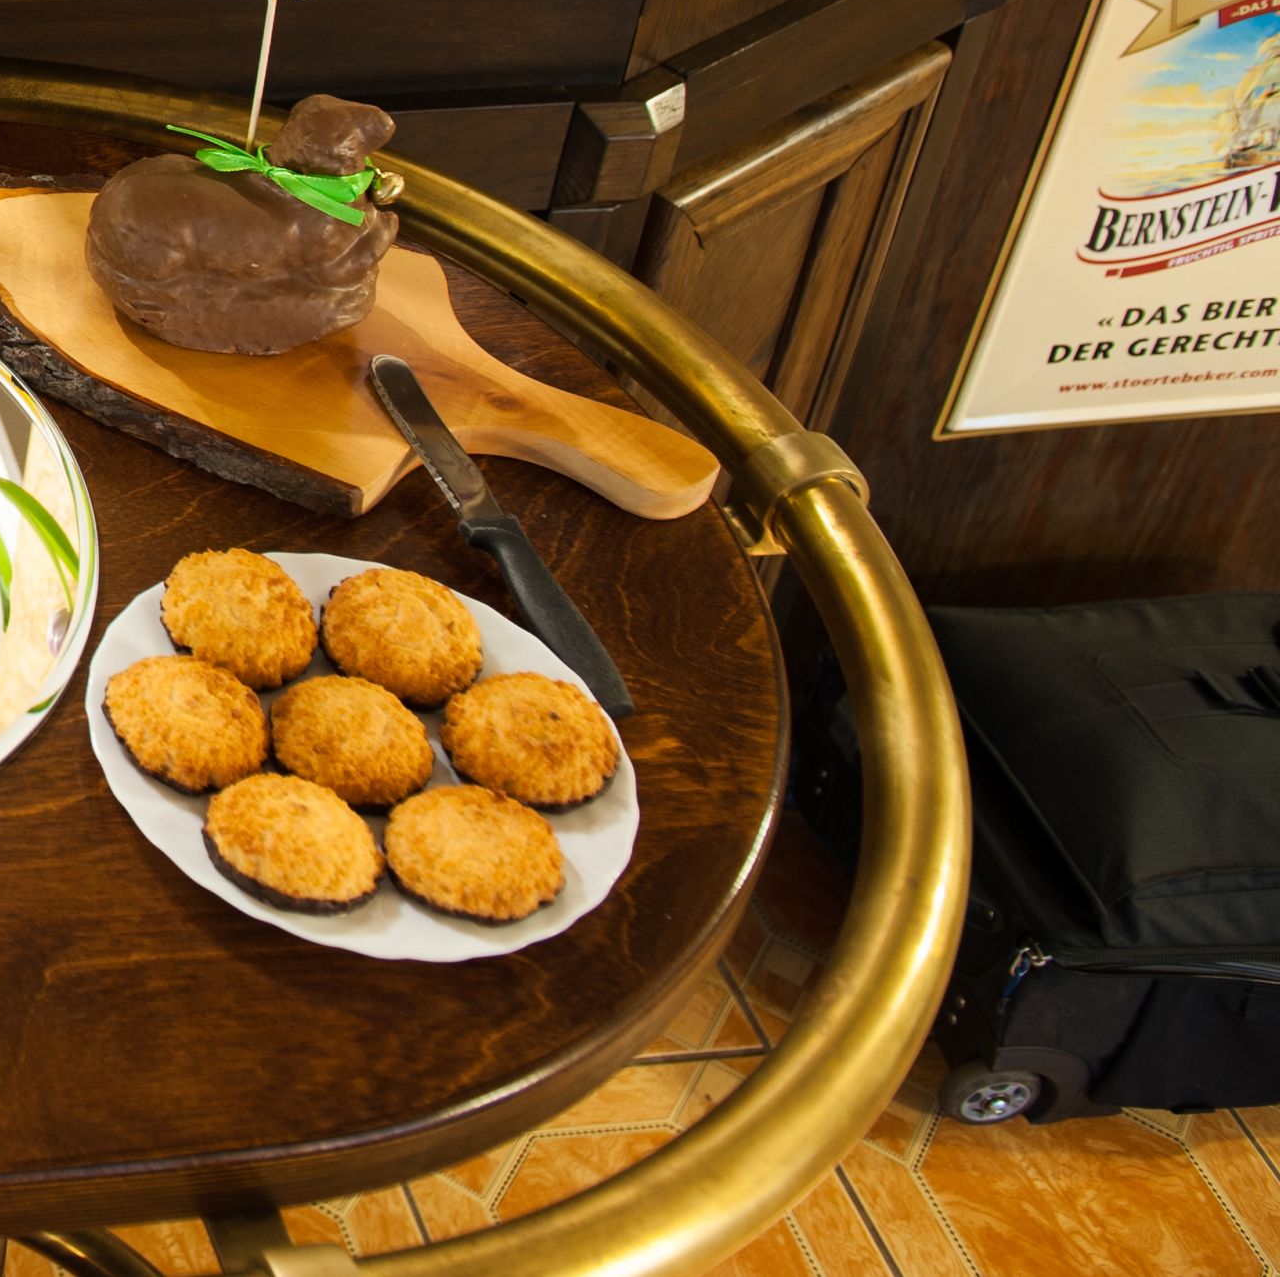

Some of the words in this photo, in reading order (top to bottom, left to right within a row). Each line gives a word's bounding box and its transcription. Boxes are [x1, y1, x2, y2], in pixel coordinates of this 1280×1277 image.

[1121, 303, 1192, 328] DAS
[1202, 297, 1278, 322] BIER
[1047, 341, 1116, 364] DER
[1127, 328, 1280, 357] GERECHT
[1058, 367, 1278, 394] www.stoertebeker.com
